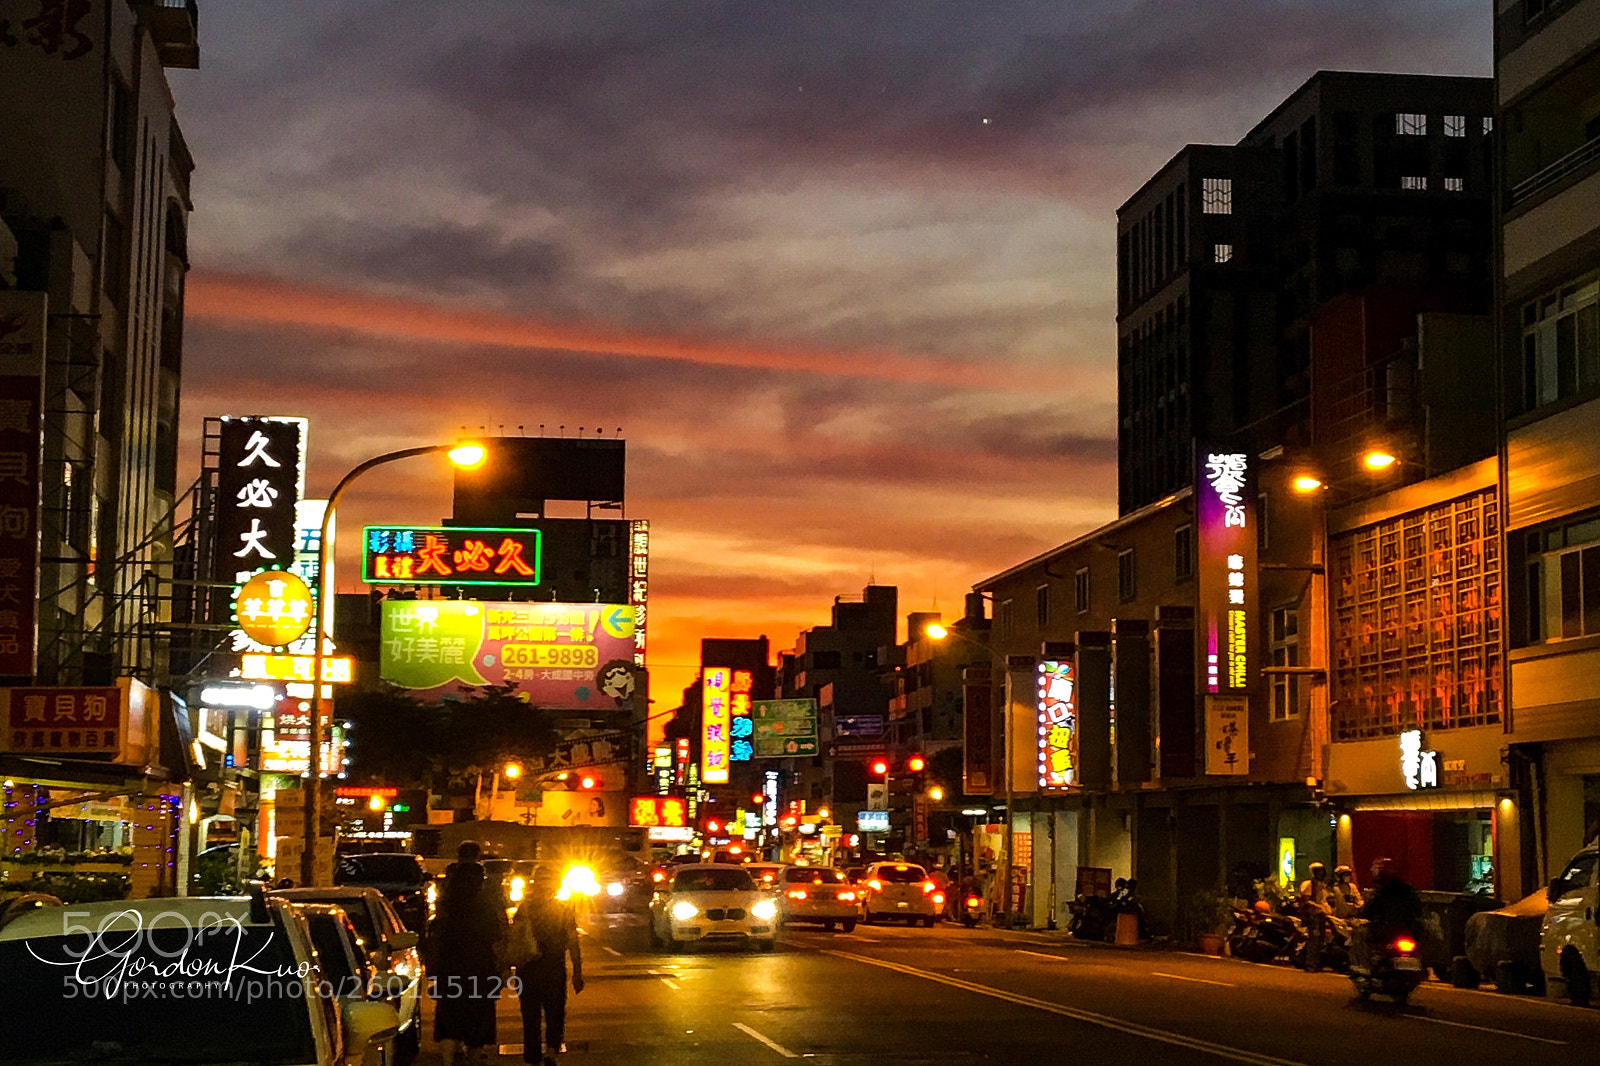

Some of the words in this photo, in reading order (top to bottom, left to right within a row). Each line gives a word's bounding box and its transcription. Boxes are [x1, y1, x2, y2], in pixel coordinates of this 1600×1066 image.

[388, 606, 439, 635] 世界
[383, 637, 466, 666] 好美麗
[504, 647, 597, 666] 261-9898
